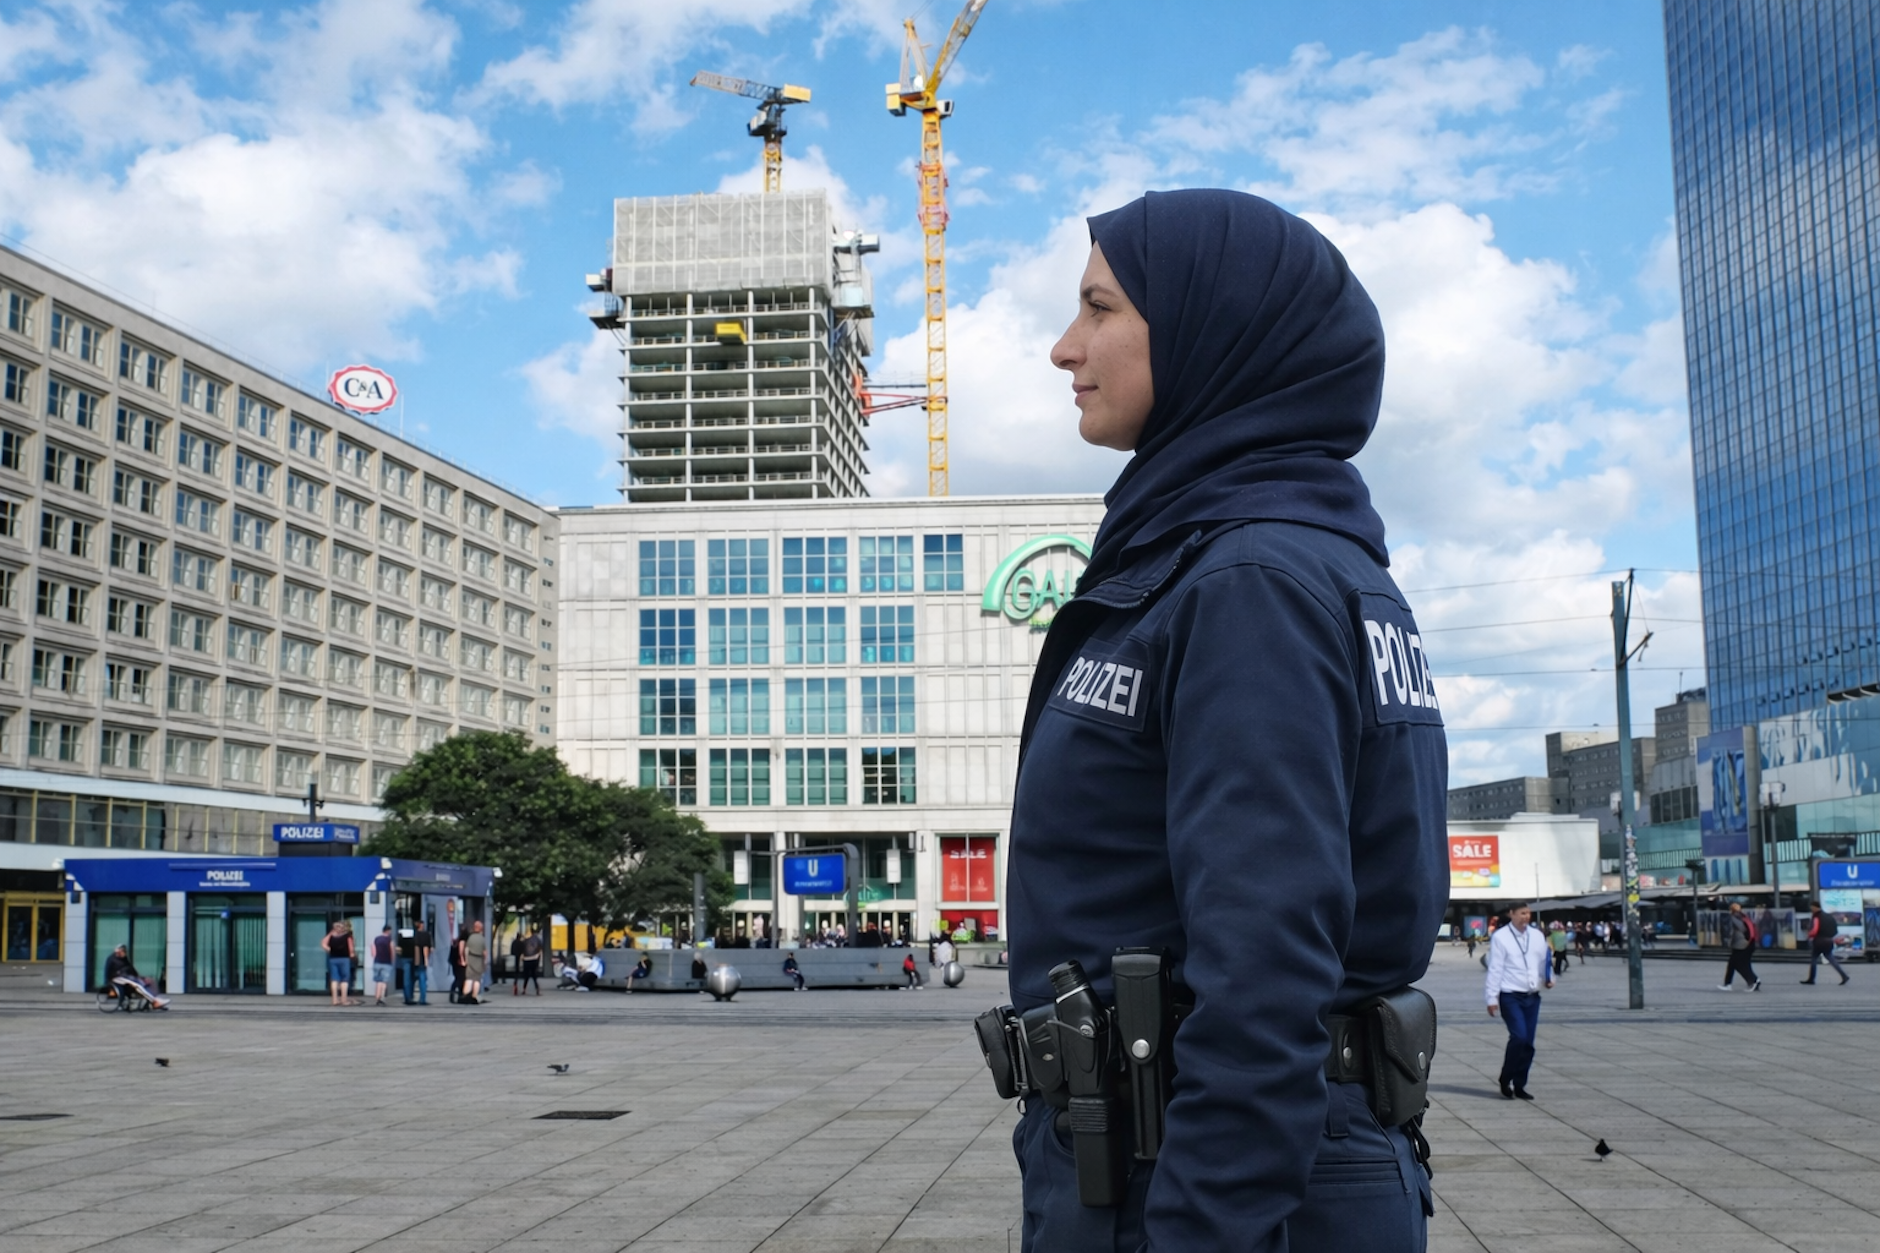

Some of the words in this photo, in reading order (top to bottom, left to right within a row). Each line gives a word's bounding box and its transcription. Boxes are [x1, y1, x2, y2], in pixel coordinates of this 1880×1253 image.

[344, 377, 384, 400] C&A
[1004, 567, 1084, 620] GAL
[1057, 656, 1143, 717] POLIZEI
[281, 826, 324, 839] POLIZEI
[1452, 844, 1492, 858] SALE
[808, 859, 818, 877] U
[1847, 865, 1858, 879] U
